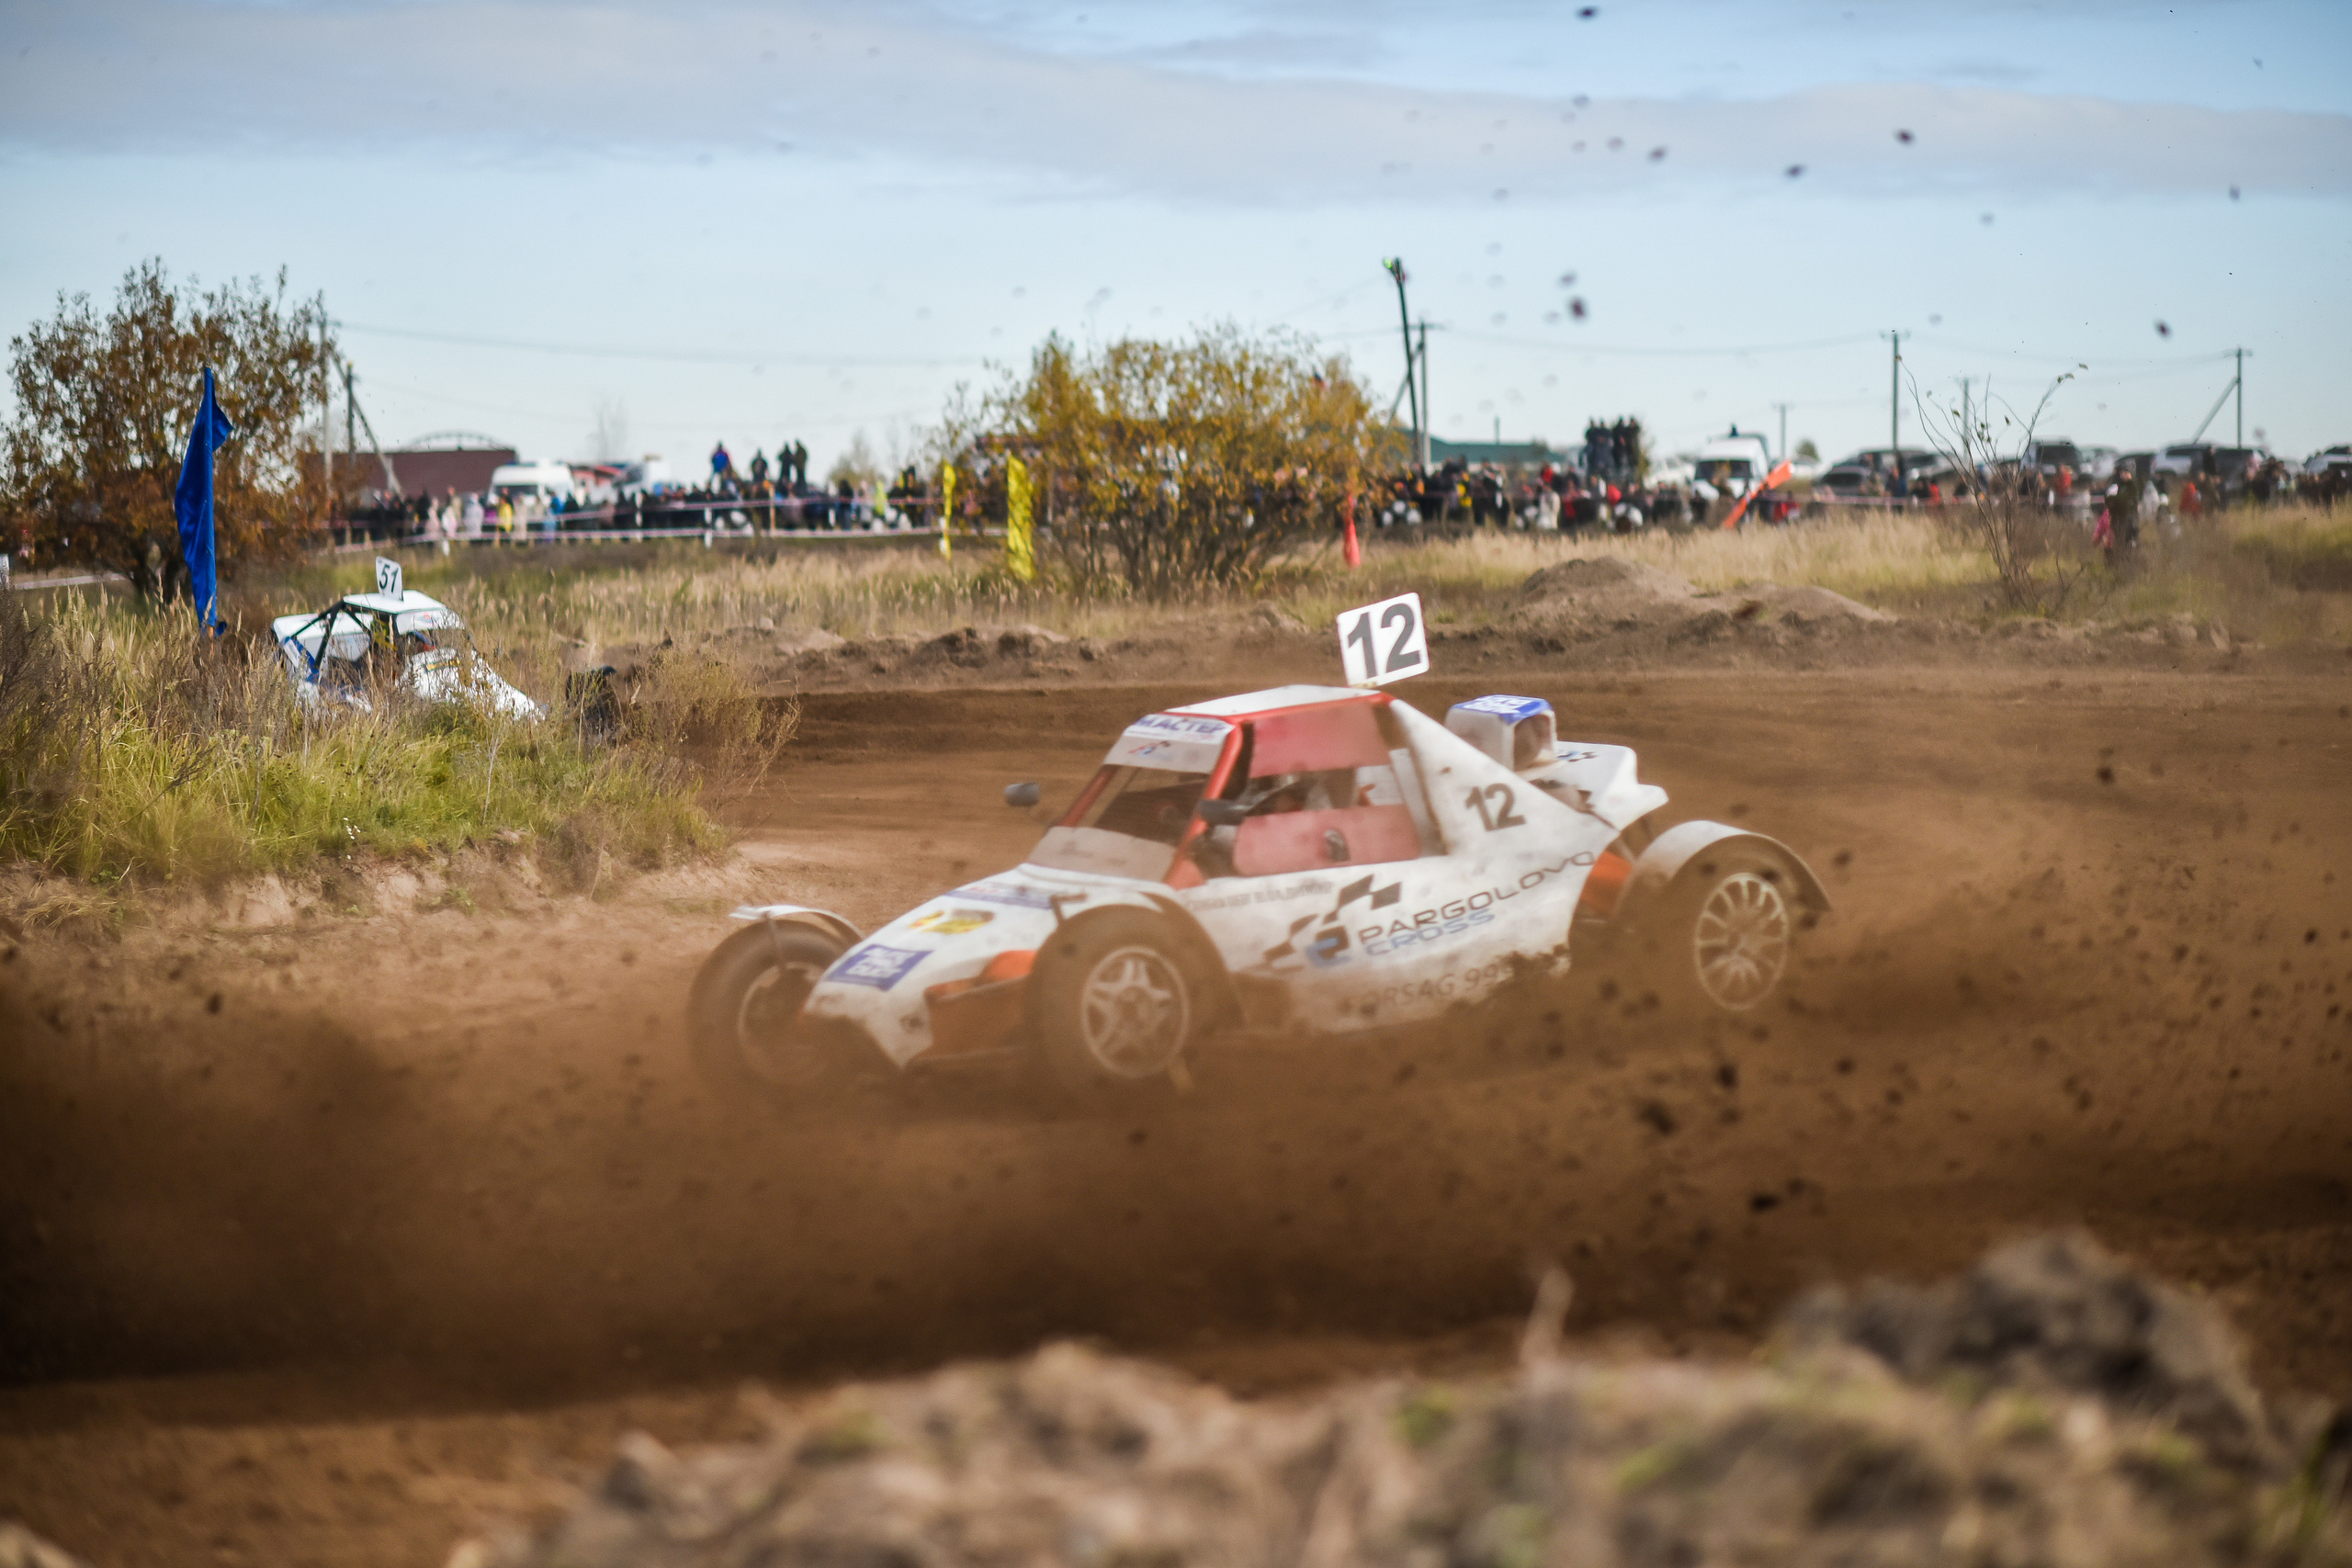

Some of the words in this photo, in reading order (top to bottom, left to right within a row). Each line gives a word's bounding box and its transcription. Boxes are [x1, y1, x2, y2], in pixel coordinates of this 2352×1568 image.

[379, 563, 399, 593] 51
[1347, 603, 1421, 680] 12
[1464, 782, 1527, 832] 12
[1358, 851, 1595, 945] PARGOLOVO
[1364, 908, 1496, 957] CROSS
